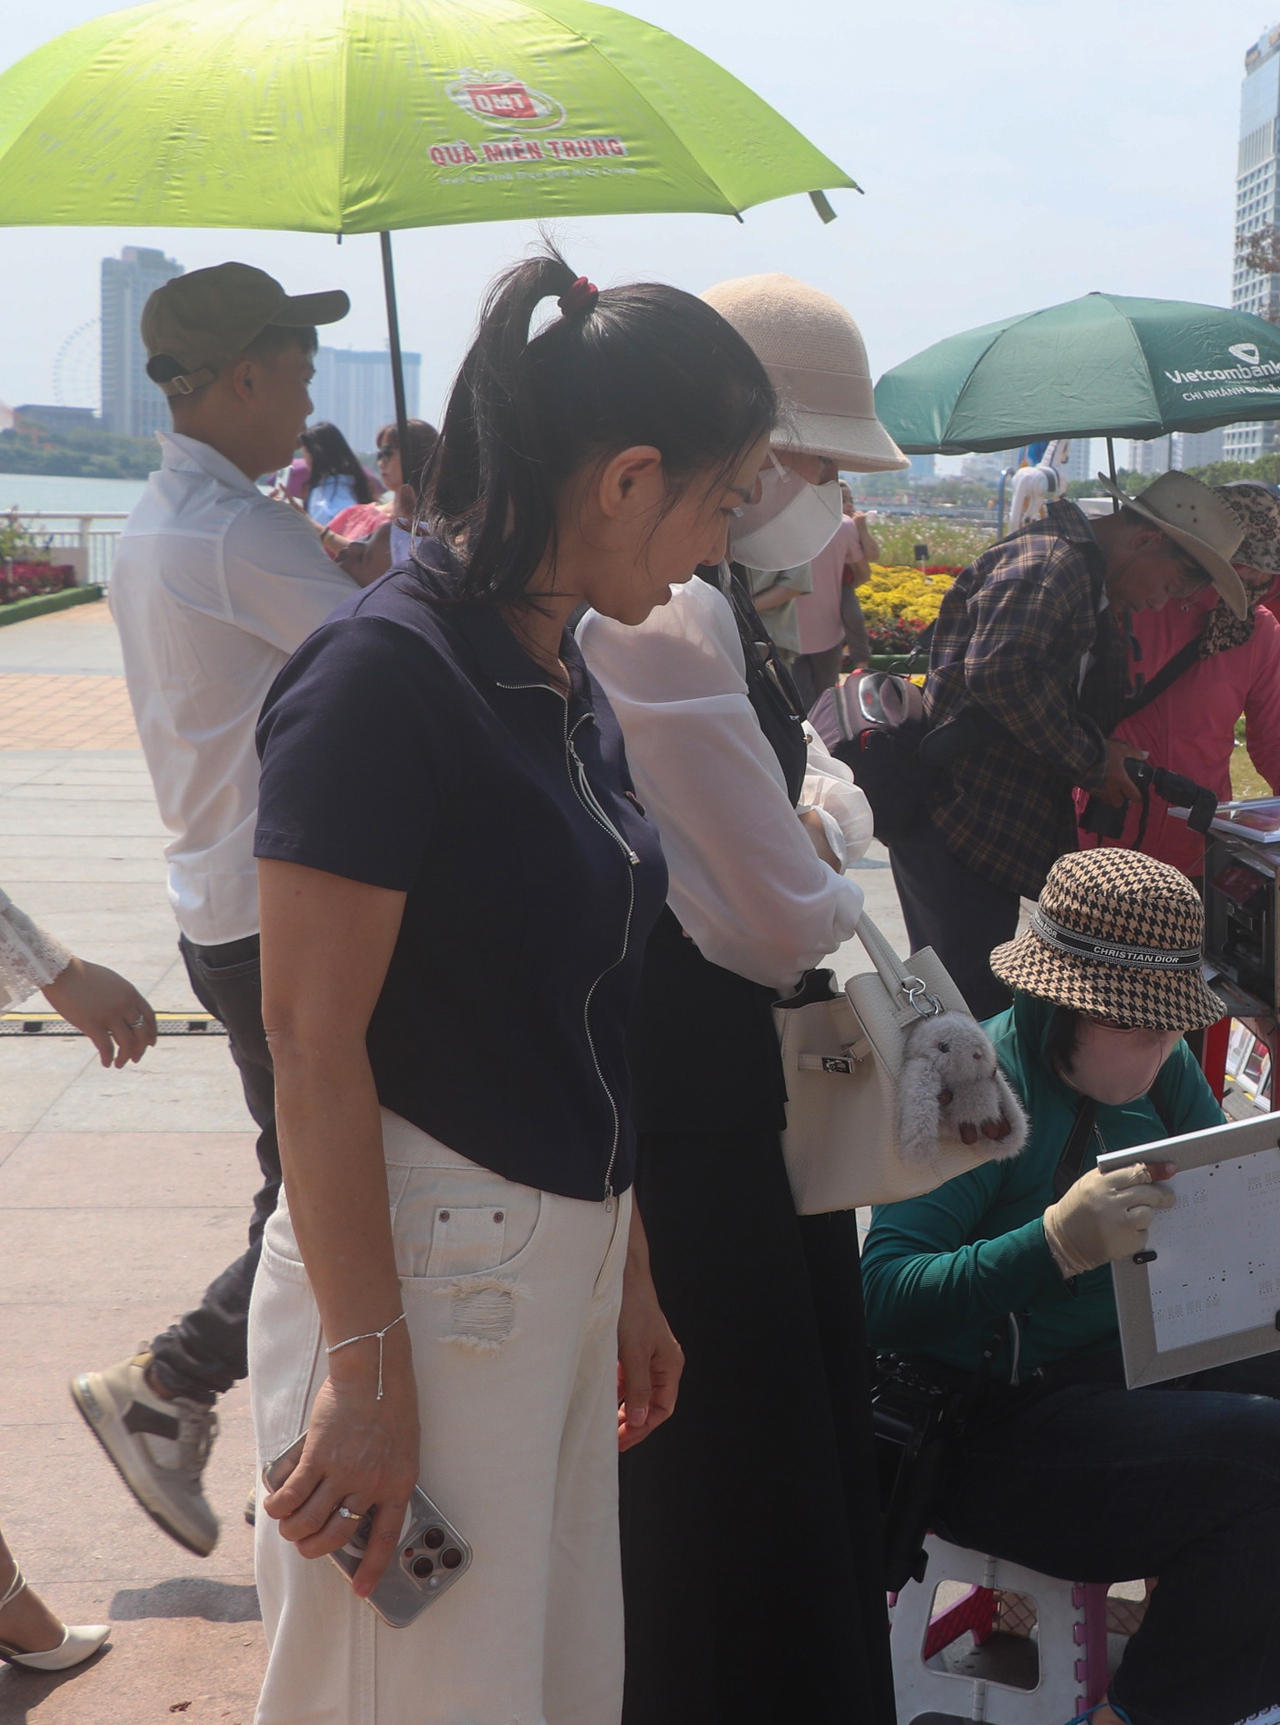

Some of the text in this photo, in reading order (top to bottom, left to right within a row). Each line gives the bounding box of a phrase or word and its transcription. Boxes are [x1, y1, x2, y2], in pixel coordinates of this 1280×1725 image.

[476, 93, 524, 112] QMT
[429, 140, 478, 166] QUÀ
[546, 139, 625, 158] TRUNG
[1182, 390, 1204, 401] CHI
[1204, 386, 1246, 399] NHÁNH
[1093, 946, 1180, 964] CHRISTIAN DIOR
